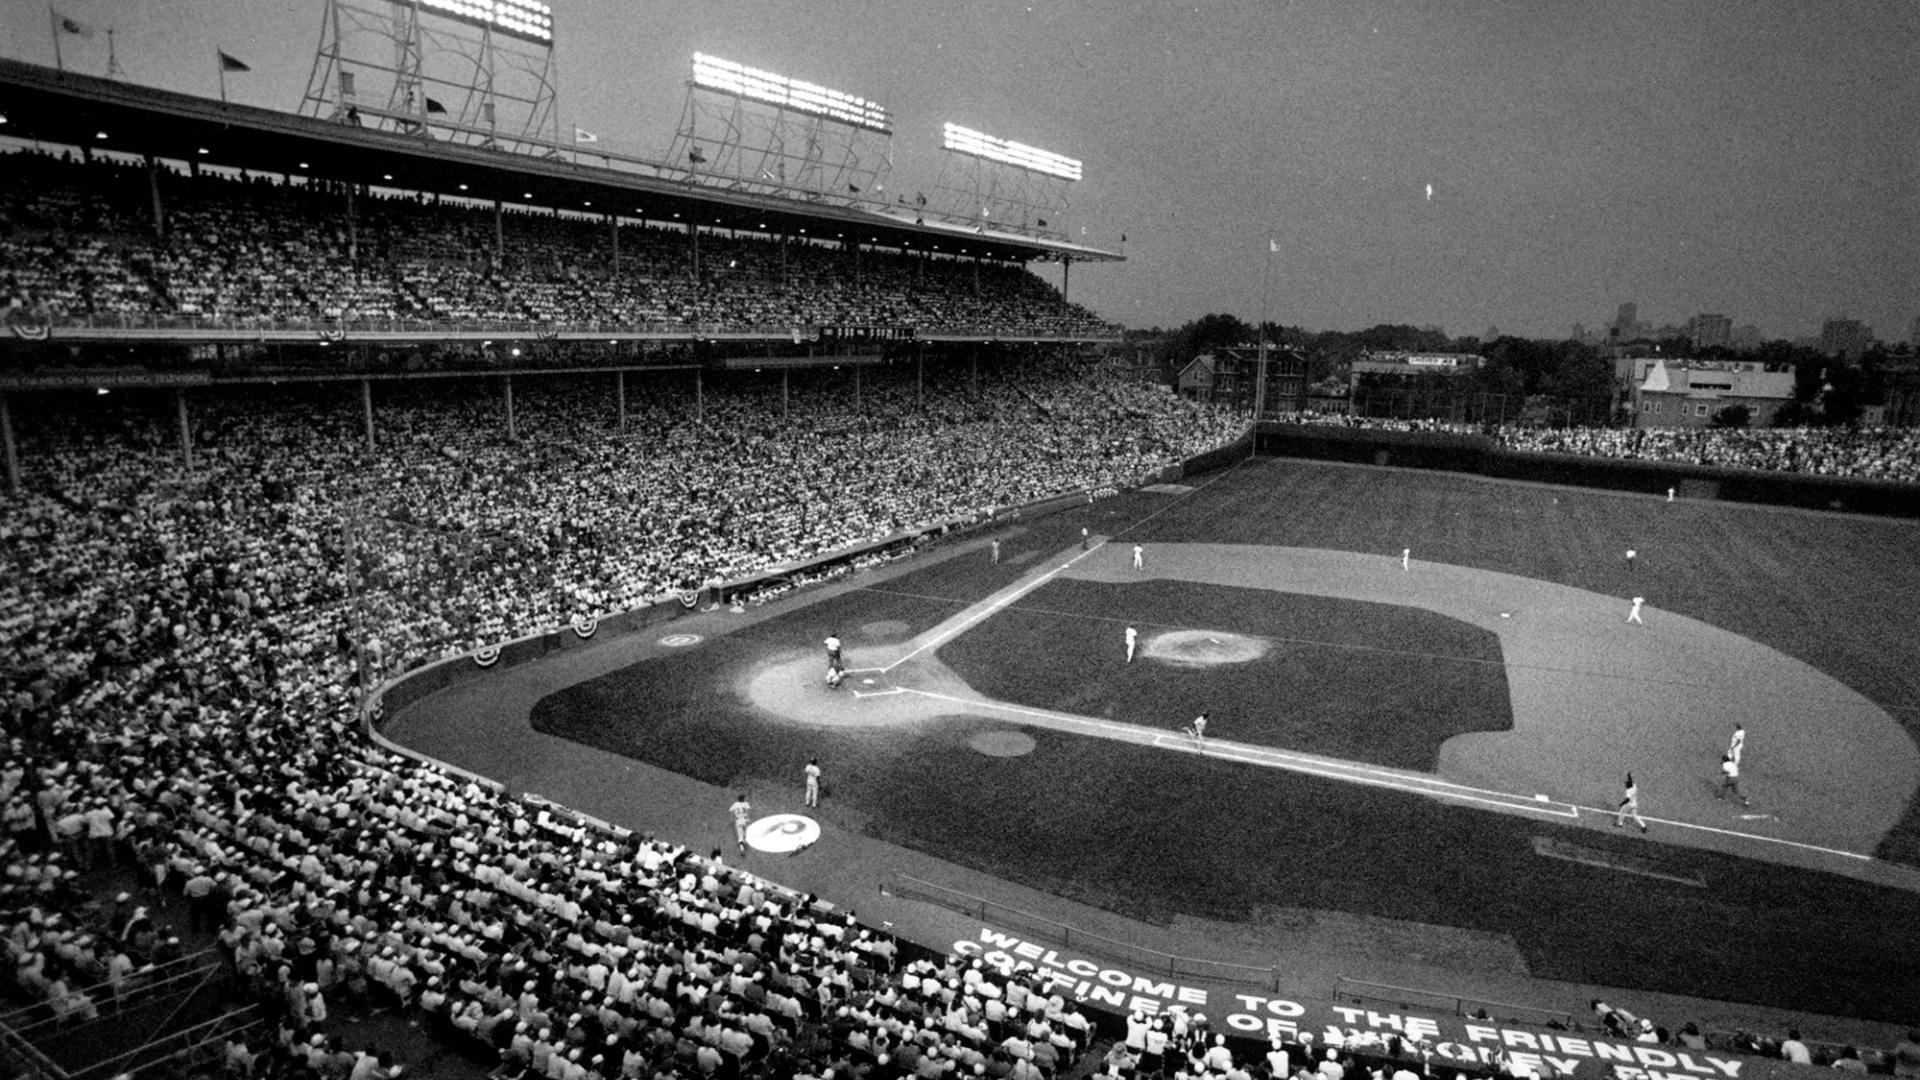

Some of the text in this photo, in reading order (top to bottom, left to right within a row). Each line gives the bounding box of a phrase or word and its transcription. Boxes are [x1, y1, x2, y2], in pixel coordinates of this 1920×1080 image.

[953, 940, 1186, 1018] COFINE
[1226, 1013, 1297, 1040] OF
[980, 928, 1742, 1077] WELCOME TO THE FRIENDLY
